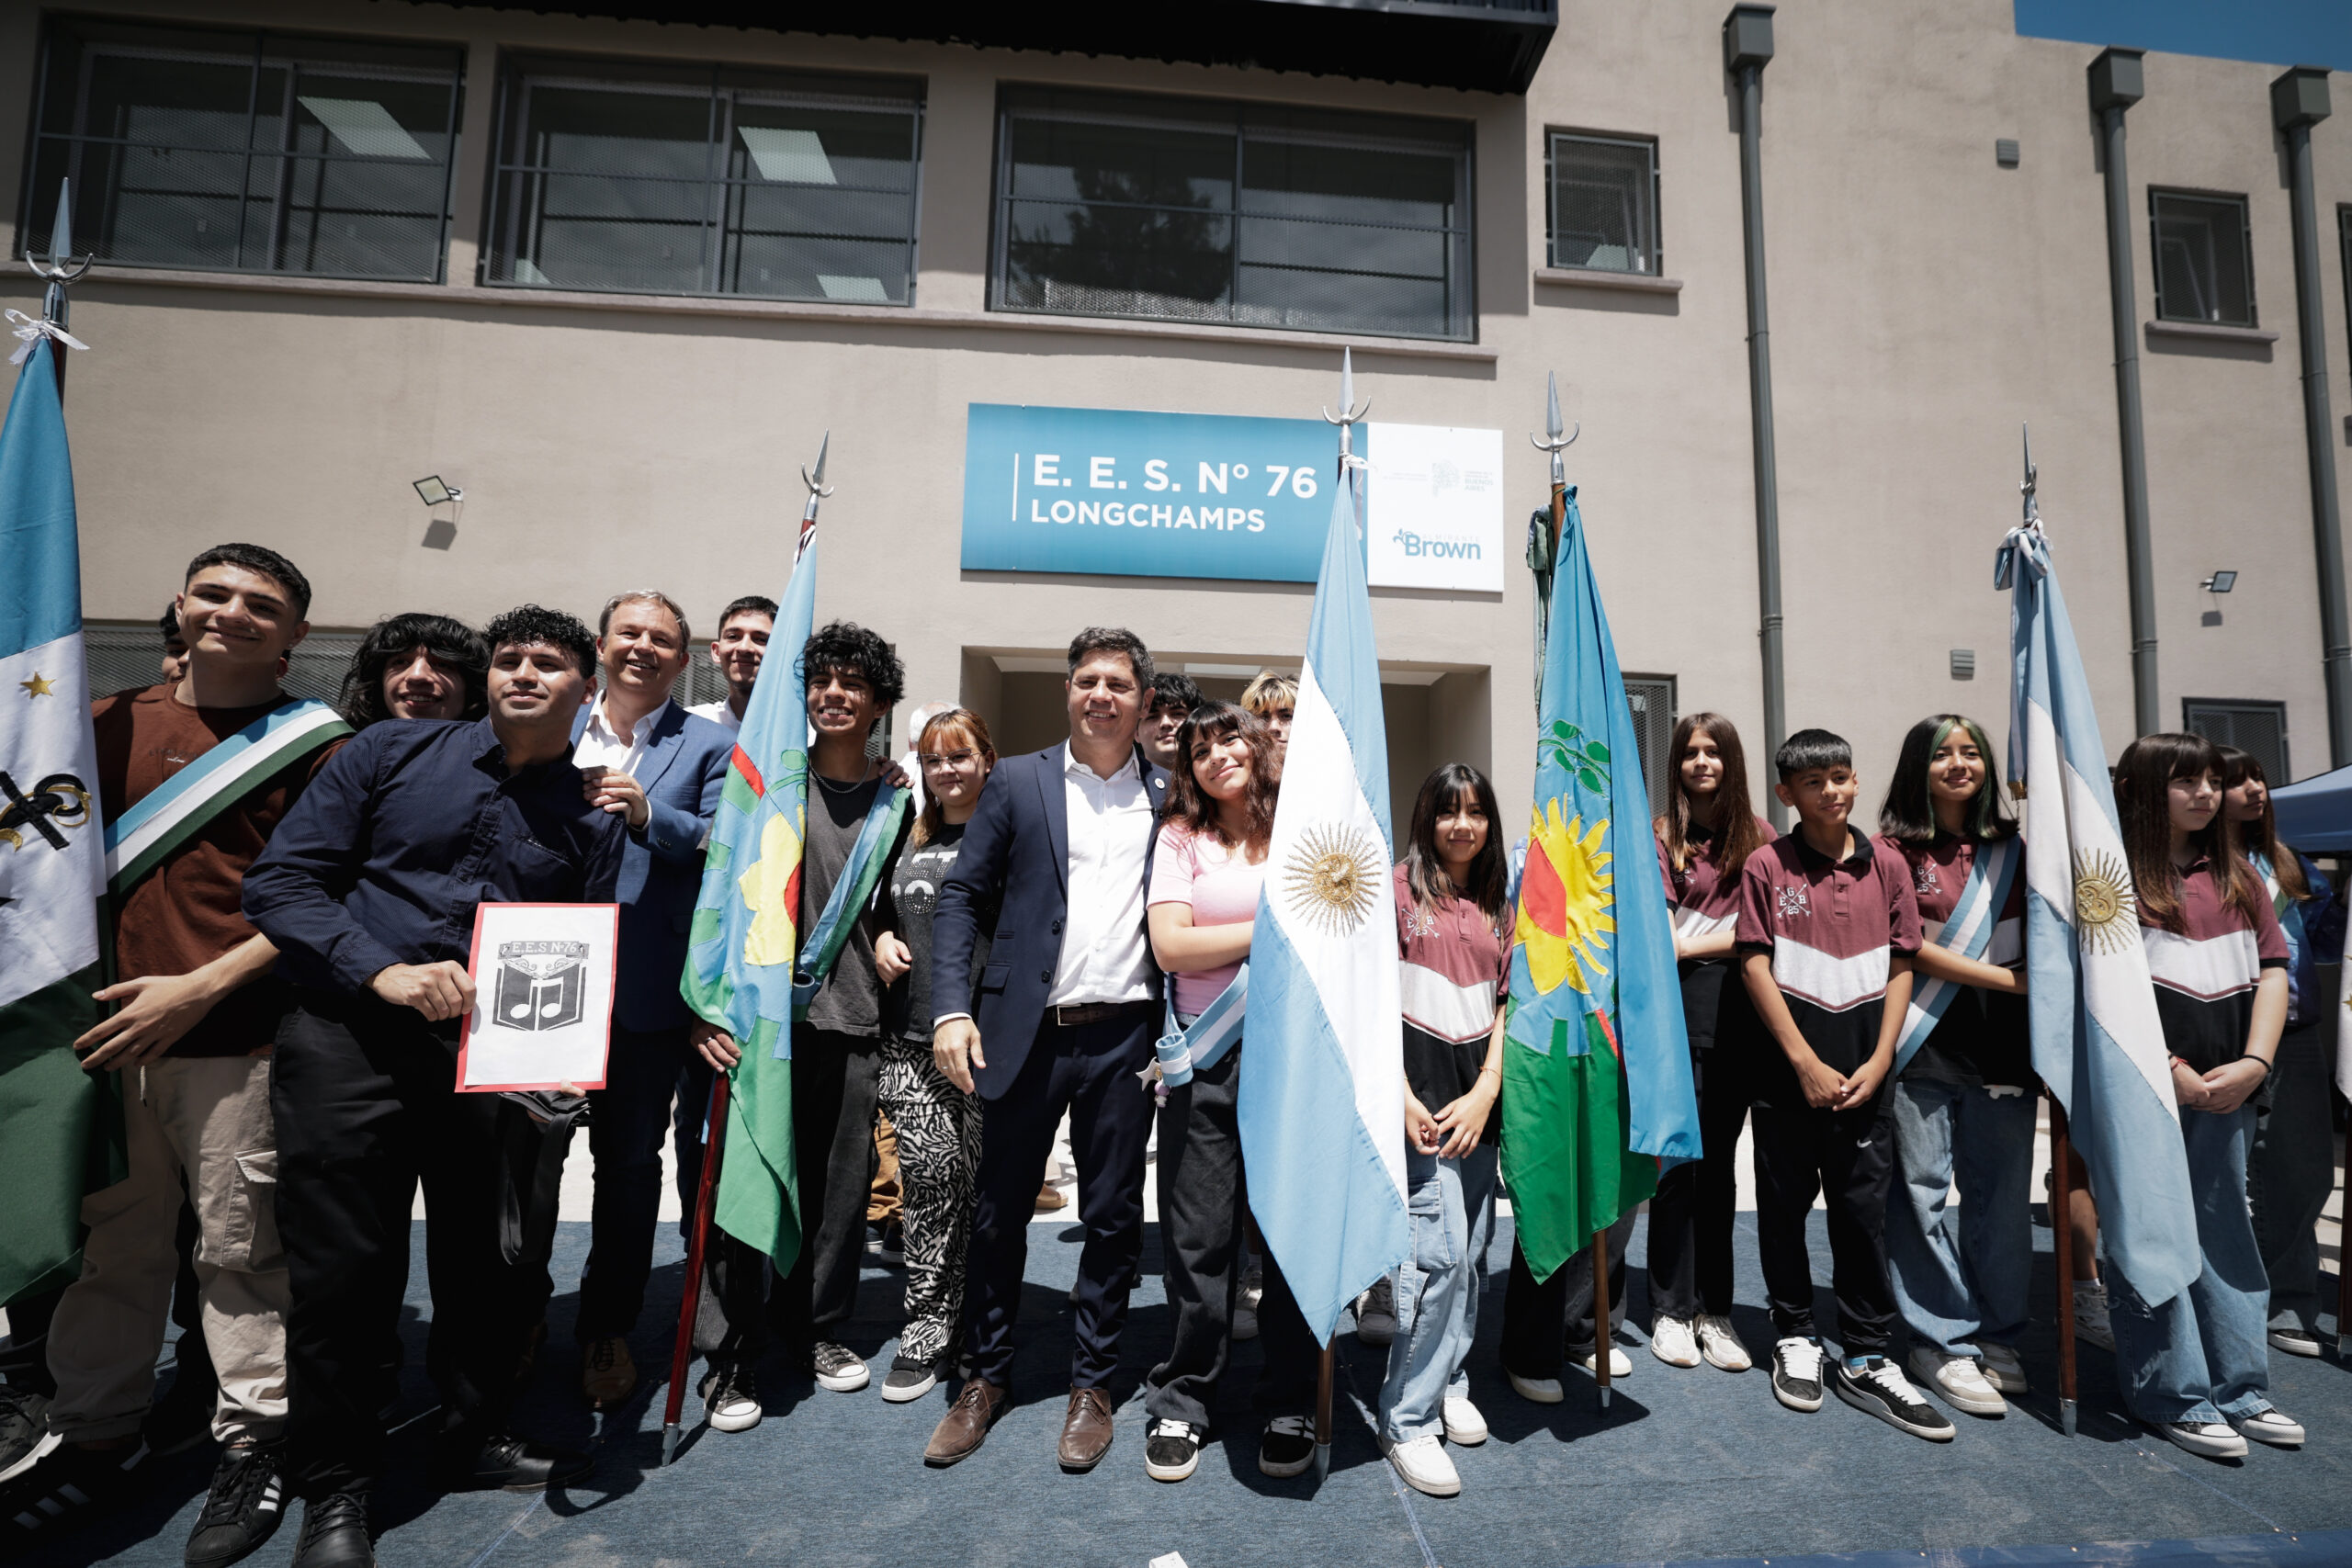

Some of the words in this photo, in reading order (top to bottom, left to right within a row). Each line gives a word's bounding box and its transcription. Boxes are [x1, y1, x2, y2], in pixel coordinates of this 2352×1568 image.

[1034, 454, 1072, 487] E.
[1090, 457, 1127, 490] E.
[1143, 459, 1182, 492] S.
[1266, 465, 1317, 499] 76
[1031, 499, 1266, 533] LONGCHAMPS
[1405, 534, 1482, 560] Brown
[1786, 886, 1795, 897] G
[1779, 897, 1787, 907] E
[1787, 906, 1800, 915] 25
[1407, 919, 1415, 929] E
